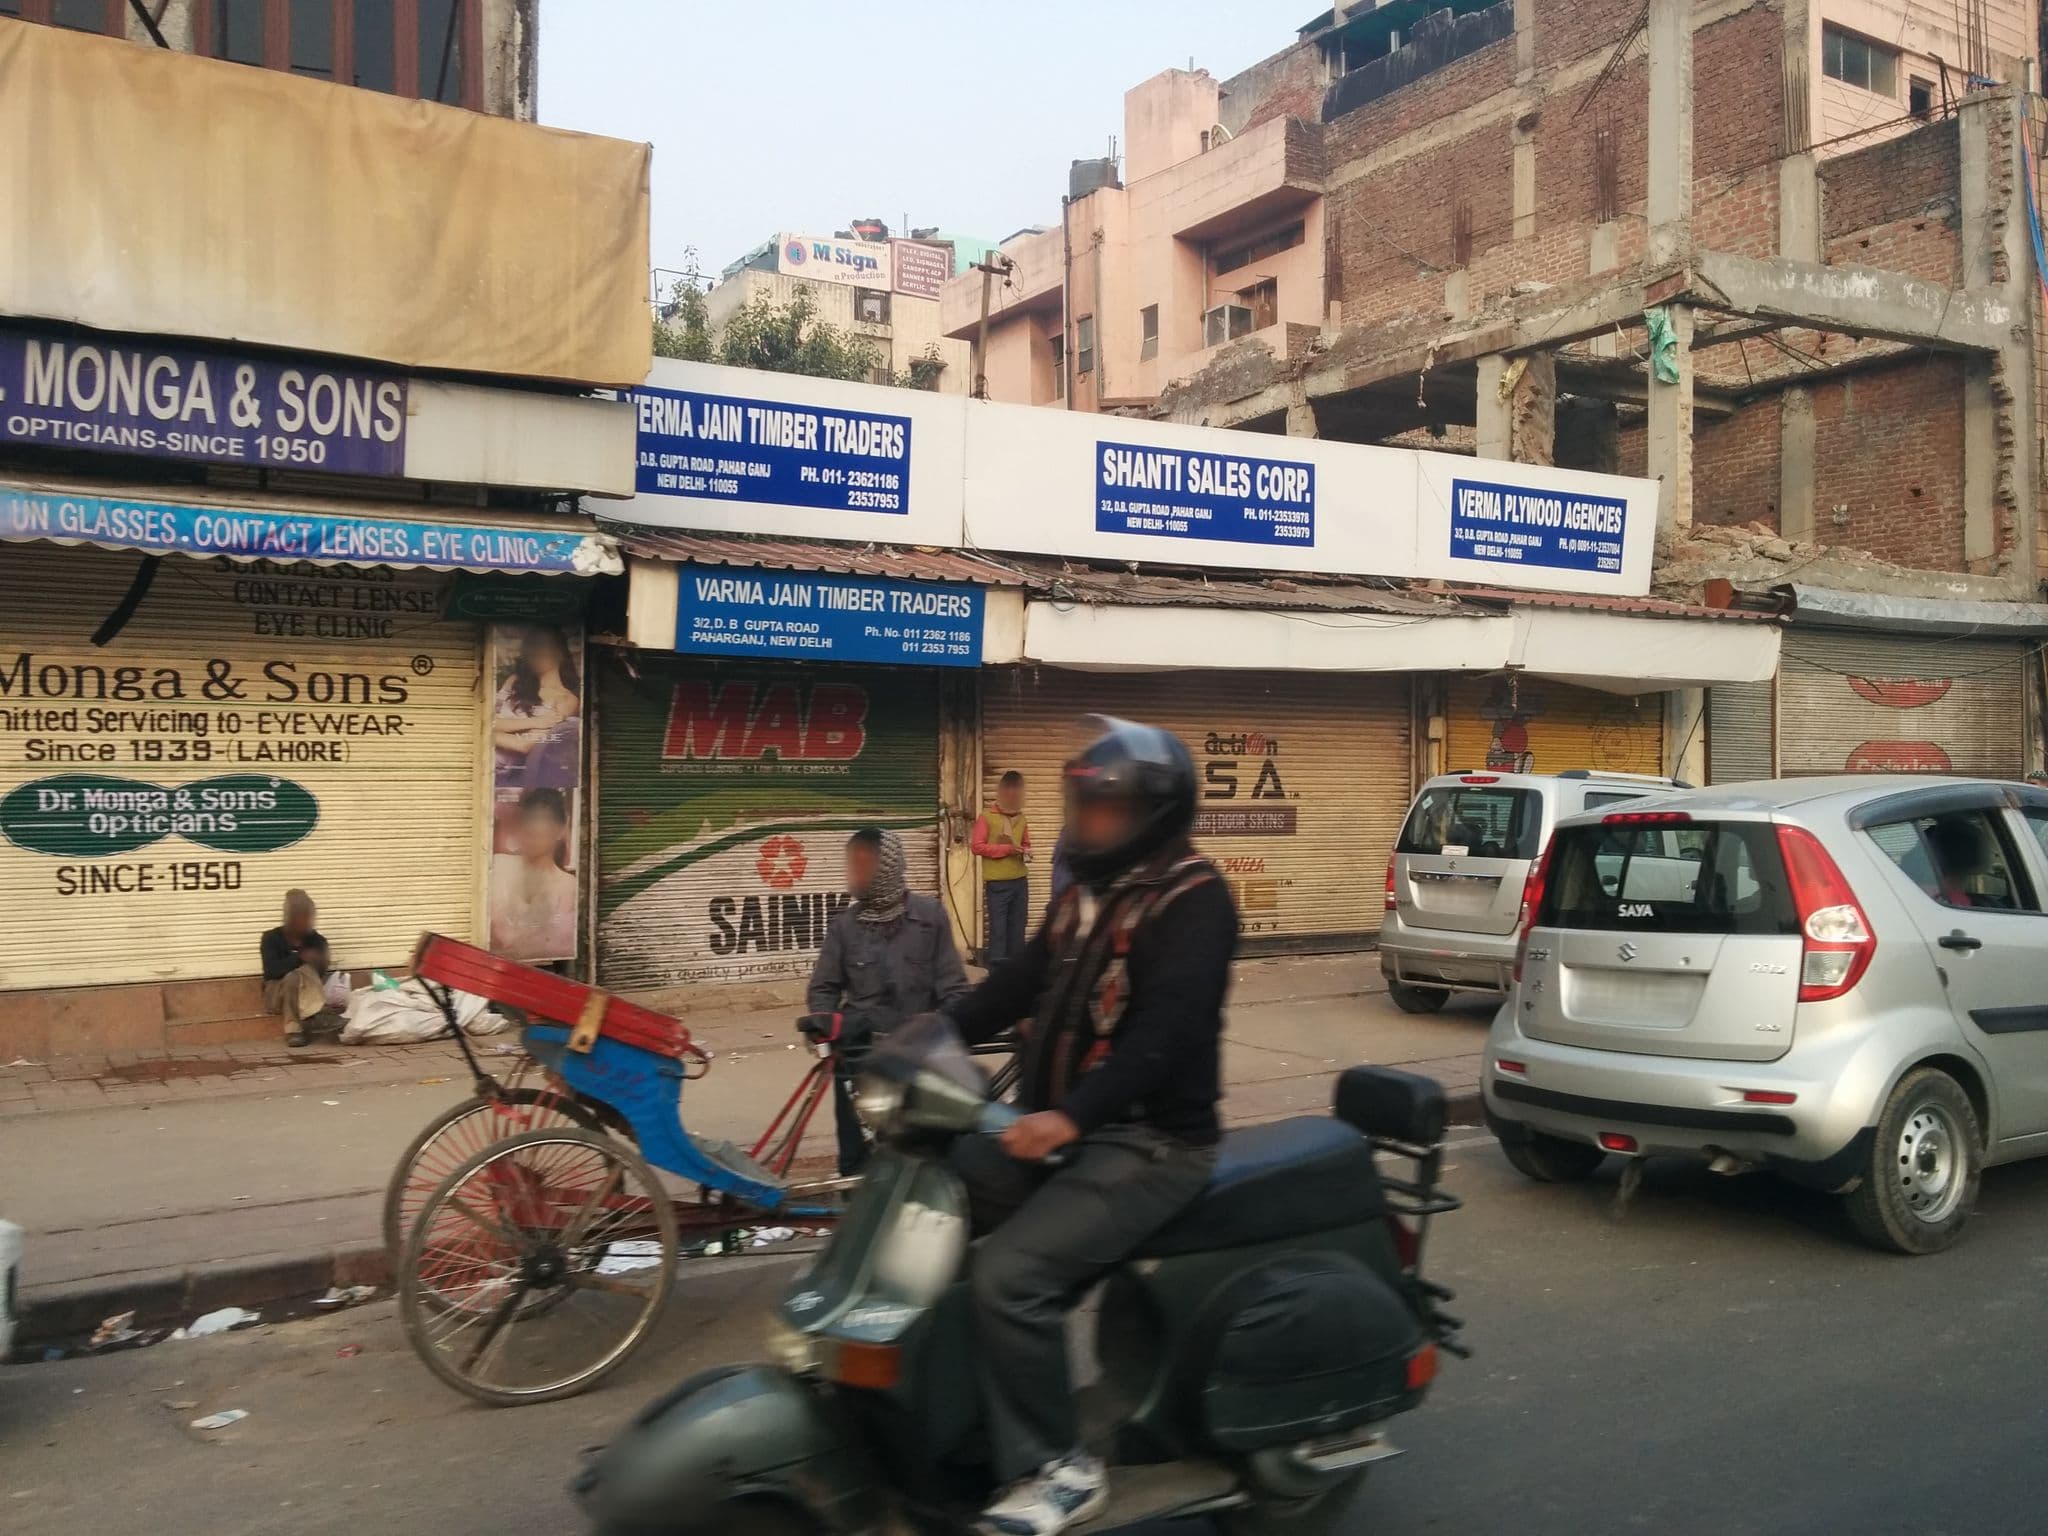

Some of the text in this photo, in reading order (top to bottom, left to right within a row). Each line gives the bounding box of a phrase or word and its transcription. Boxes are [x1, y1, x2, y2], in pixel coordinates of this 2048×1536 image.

[813, 242, 831, 262] M
[835, 246, 878, 272] Sign
[24, 339, 401, 441] MONGA & SONS
[7, 416, 326, 463] OPTICIANS-SINCE 1950
[698, 403, 742, 443] JAIN
[747, 407, 818, 451] TIMBER
[822, 416, 904, 459] TRADERS
[640, 451, 658, 467] D.B.
[660, 453, 689, 470] GUPTA
[690, 457, 714, 473] ROAD
[747, 462, 771, 478] GANJ
[1103, 448, 1311, 503] SHANTI SALES CORP.
[657, 473, 677, 489] NEW
[708, 478, 738, 494] 110055
[800, 466, 820, 483] PH.
[847, 470, 899, 490] 23621186
[847, 490, 899, 509] 23537953
[1129, 502, 1151, 515] GUPTA
[1151, 504, 1170, 516] ROAD
[1458, 488, 1622, 534] VERMA PLYWOOD AGENCIES
[1126, 516, 1143, 528] NEW
[1243, 507, 1257, 520] PH.
[194, 515, 312, 553] CONTACT
[423, 531, 464, 561] EYE
[471, 534, 541, 564] CLINIC
[233, 580, 342, 608] CONTACT
[696, 578, 971, 618] VARMA JAIN TIMBER TRADERS
[254, 612, 304, 636] EYE
[744, 620, 783, 632] GUPTA
[786, 622, 820, 634] ROAD
[865, 626, 971, 642] Ph. No. 011 2362 1186
[692, 632, 833, 649] PAHARGANJ, NEW DELHI
[902, 642, 970, 655] 011 2353 7953
[0, 652, 187, 701] Monga
[202, 659, 248, 700] &
[86, 708, 208, 737] Servicing
[662, 682, 868, 760] MAB
[25, 739, 115, 762] Since
[37, 788, 277, 813] Dr. Monga & Sons
[88, 812, 237, 837] Opticians
[1618, 904, 1654, 918] SAYA
